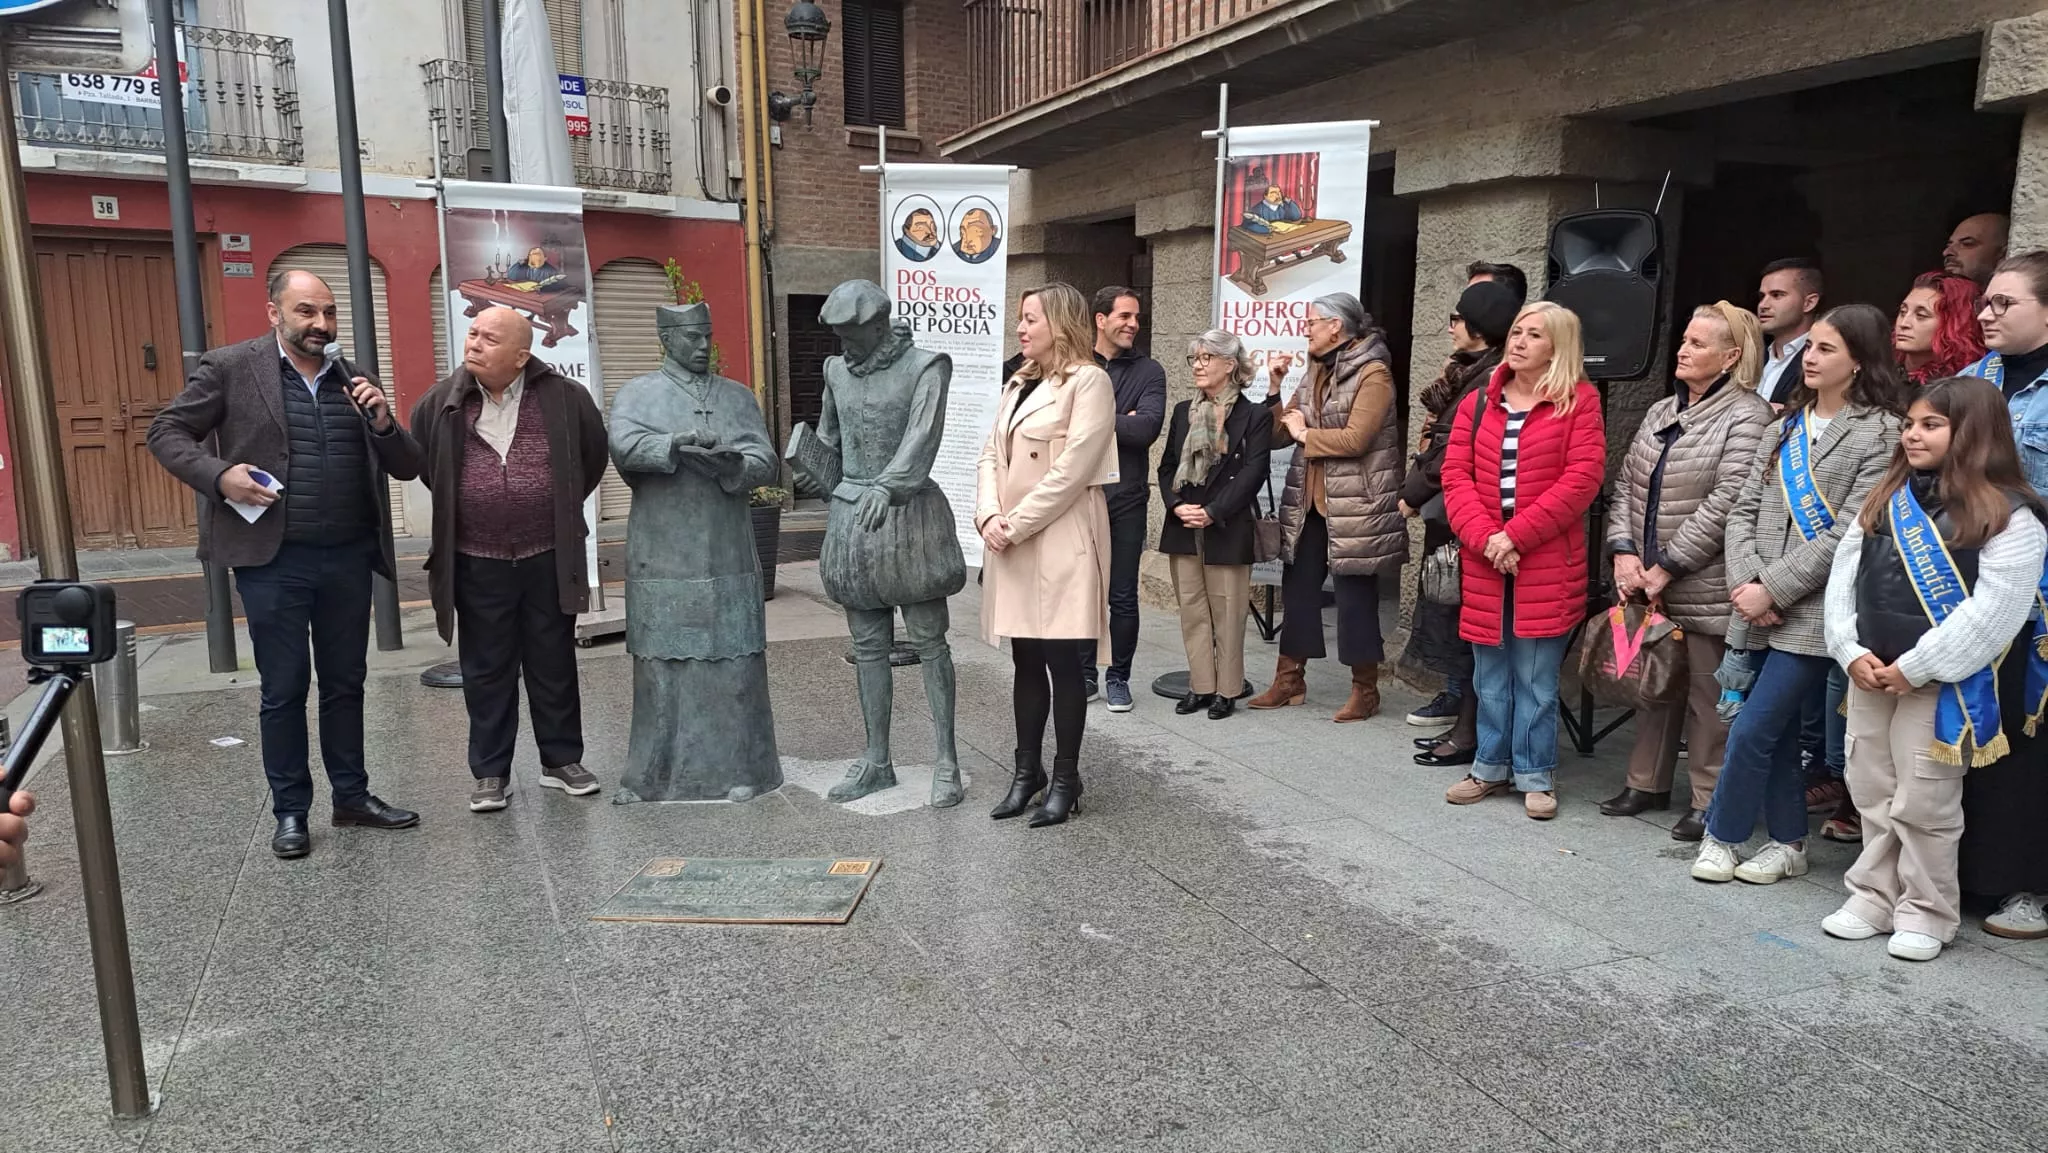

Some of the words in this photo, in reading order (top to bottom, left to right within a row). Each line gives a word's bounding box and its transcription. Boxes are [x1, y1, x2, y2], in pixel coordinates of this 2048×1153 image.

[110, 76, 145, 94] 779
[560, 80, 581, 92] NDE
[97, 201, 113, 214] 38
[897, 269, 937, 285] DOS
[897, 301, 937, 317] DOS
[1223, 301, 1311, 319] LUPERCI
[1222, 319, 1309, 337] LEONAR
[1799, 491, 1824, 535] Hon
[1902, 521, 1954, 600] Infantil
